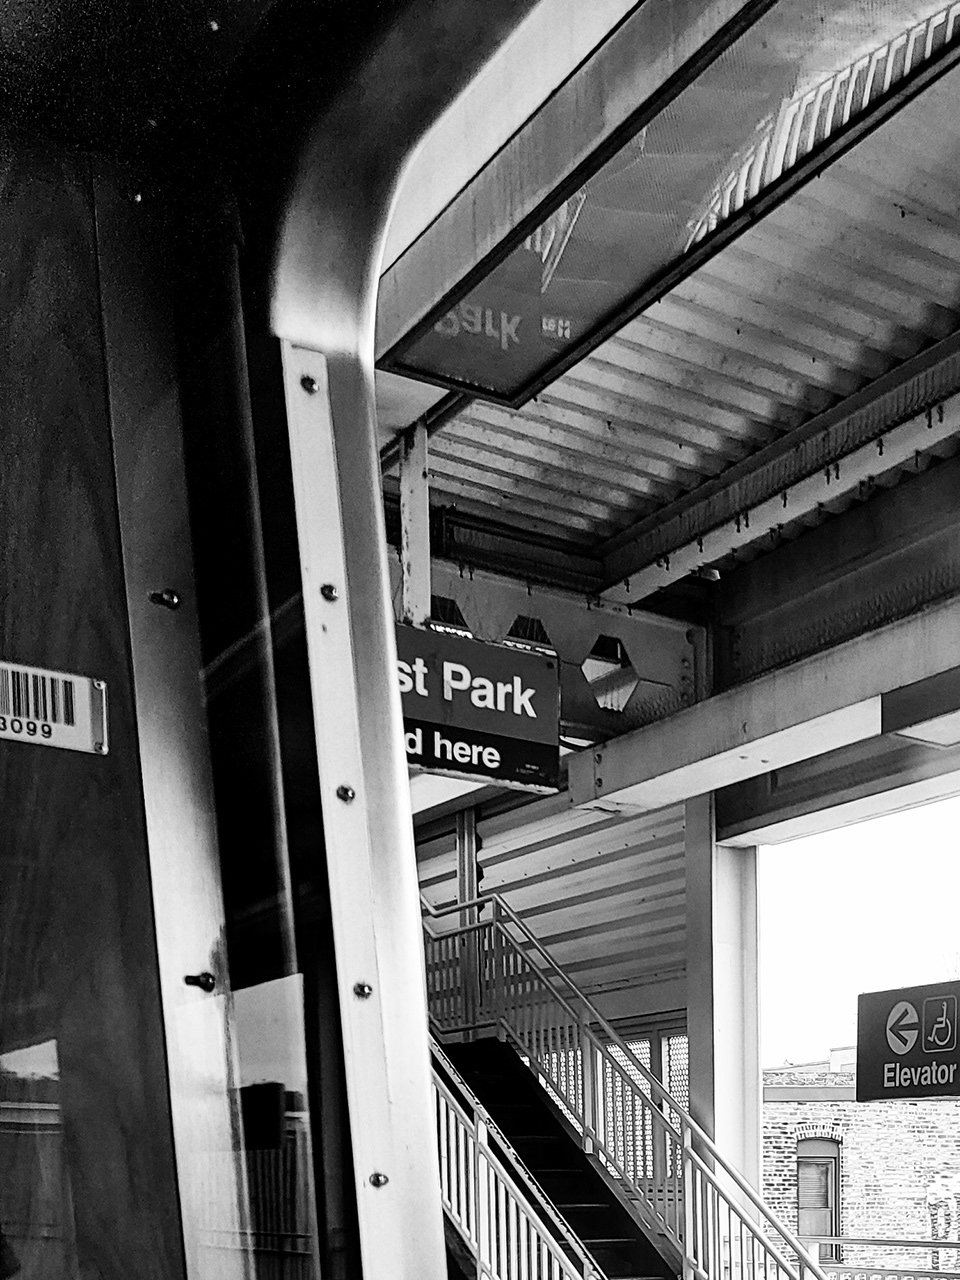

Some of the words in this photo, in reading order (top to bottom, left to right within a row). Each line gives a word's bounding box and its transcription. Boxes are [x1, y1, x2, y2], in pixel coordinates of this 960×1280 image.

[443, 661, 537, 718] Park
[434, 731, 500, 769] here
[883, 1061, 957, 1088] Elevator
